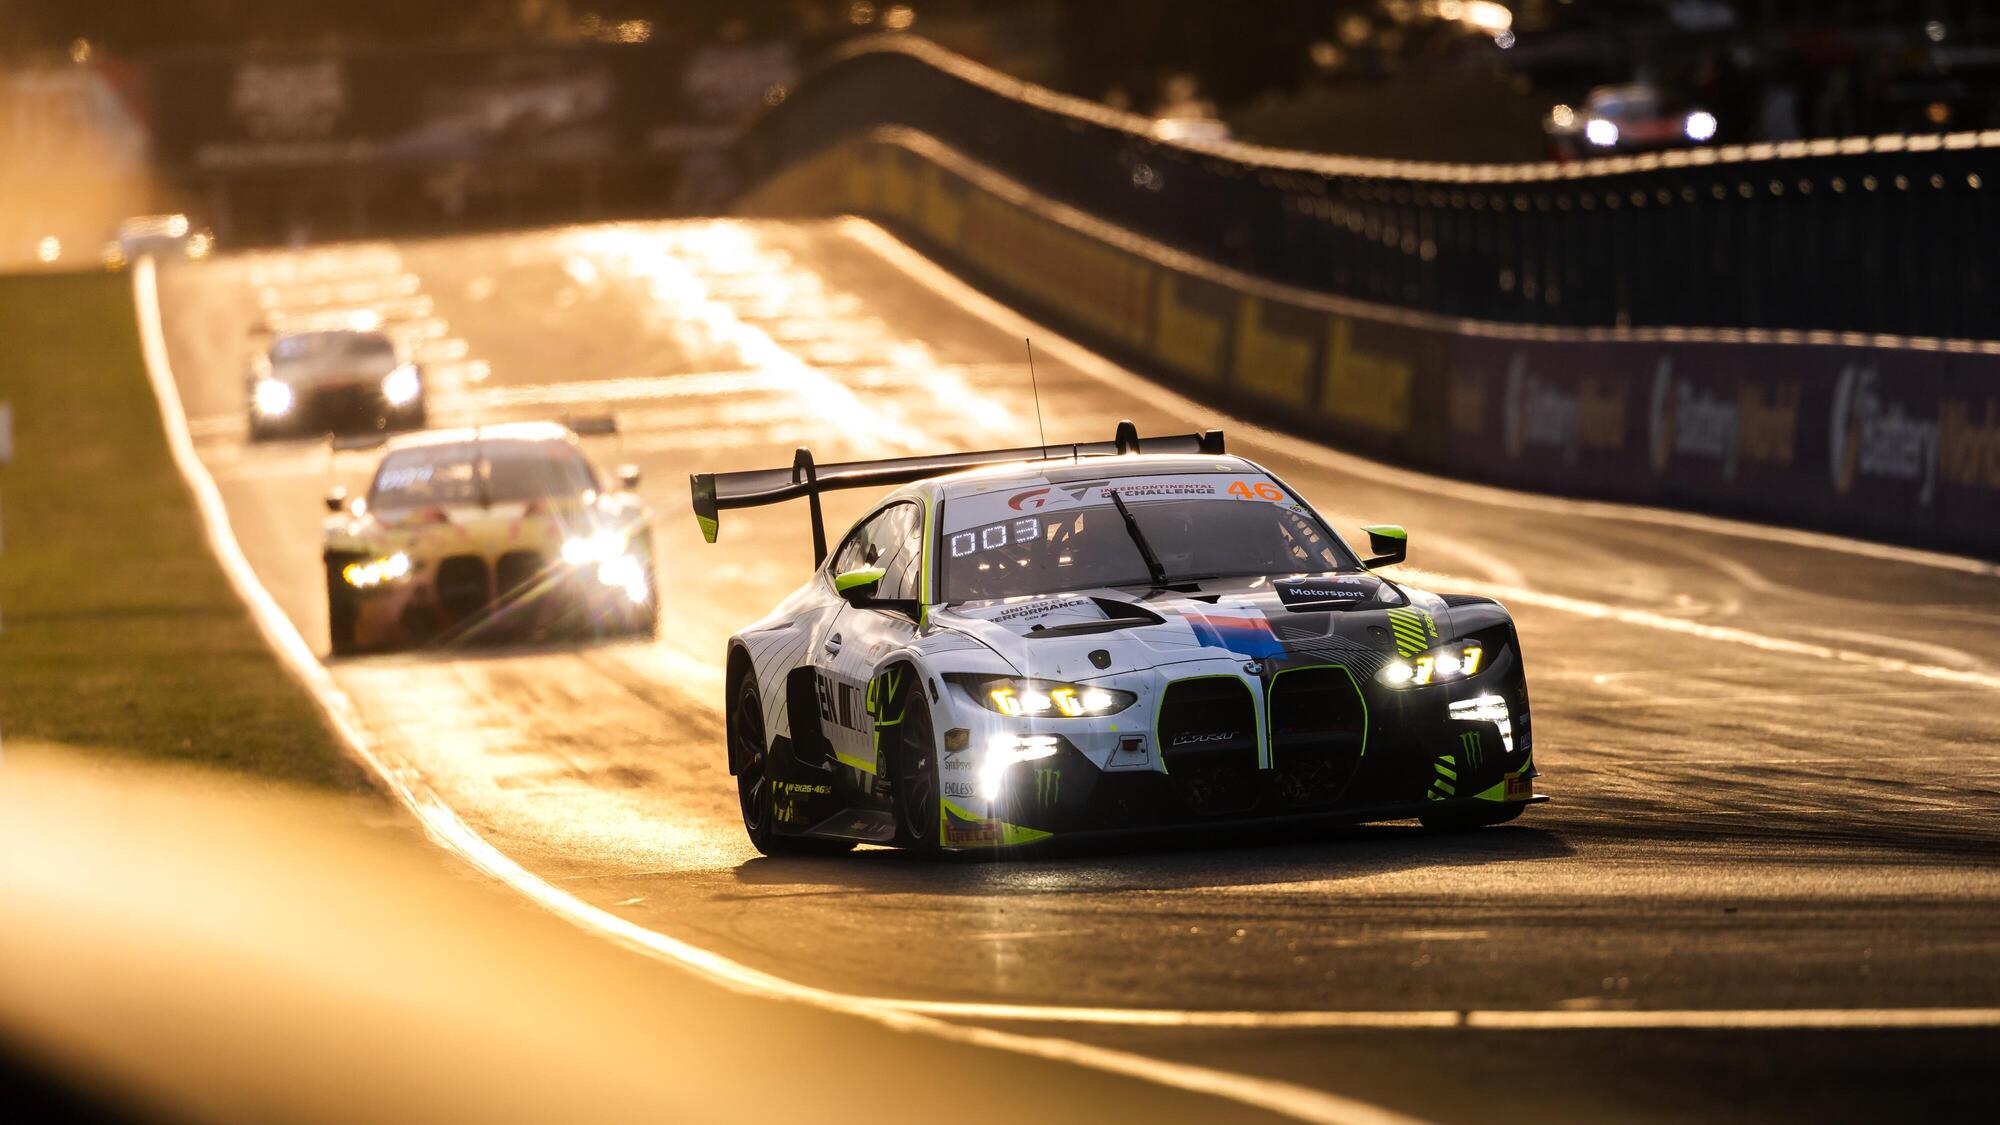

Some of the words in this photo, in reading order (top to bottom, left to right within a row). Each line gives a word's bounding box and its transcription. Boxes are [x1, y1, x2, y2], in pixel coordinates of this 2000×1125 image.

[1100, 484, 1214, 493] INTERCONTINENTAL
[1125, 489, 1215, 497] CHALLENGE
[1227, 481, 1283, 501] 46
[951, 518, 1038, 557] 003
[1289, 587, 1365, 599] Motorsport
[1000, 601, 1048, 615] UNITED
[944, 782, 975, 795] ENDLESS
